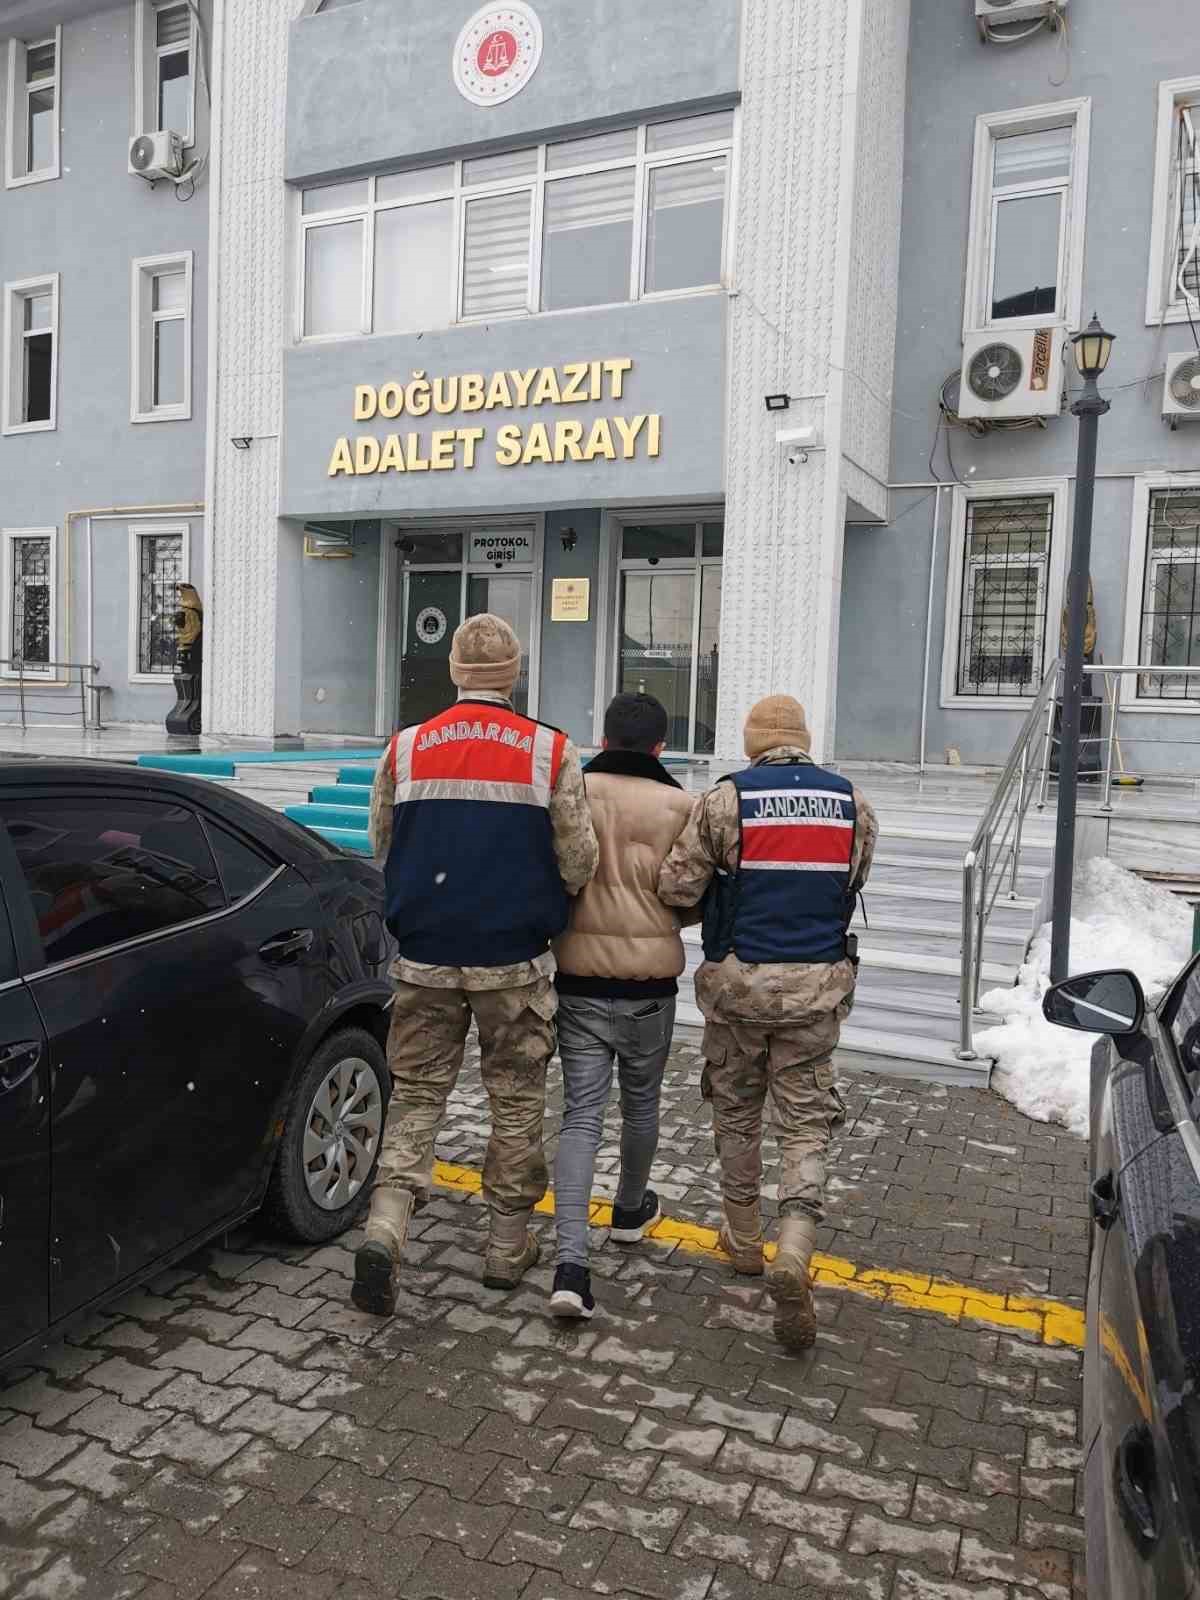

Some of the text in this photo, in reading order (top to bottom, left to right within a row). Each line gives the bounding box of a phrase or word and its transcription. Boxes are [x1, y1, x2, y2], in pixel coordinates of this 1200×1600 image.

[354, 358, 632, 421] DOĞUBAYAZIT
[328, 413, 661, 476] ADALET SARAYI
[474, 537, 529, 548] PROTOKOL
[416, 721, 533, 753] JANDARMA
[753, 796, 844, 818] JANDARMA
